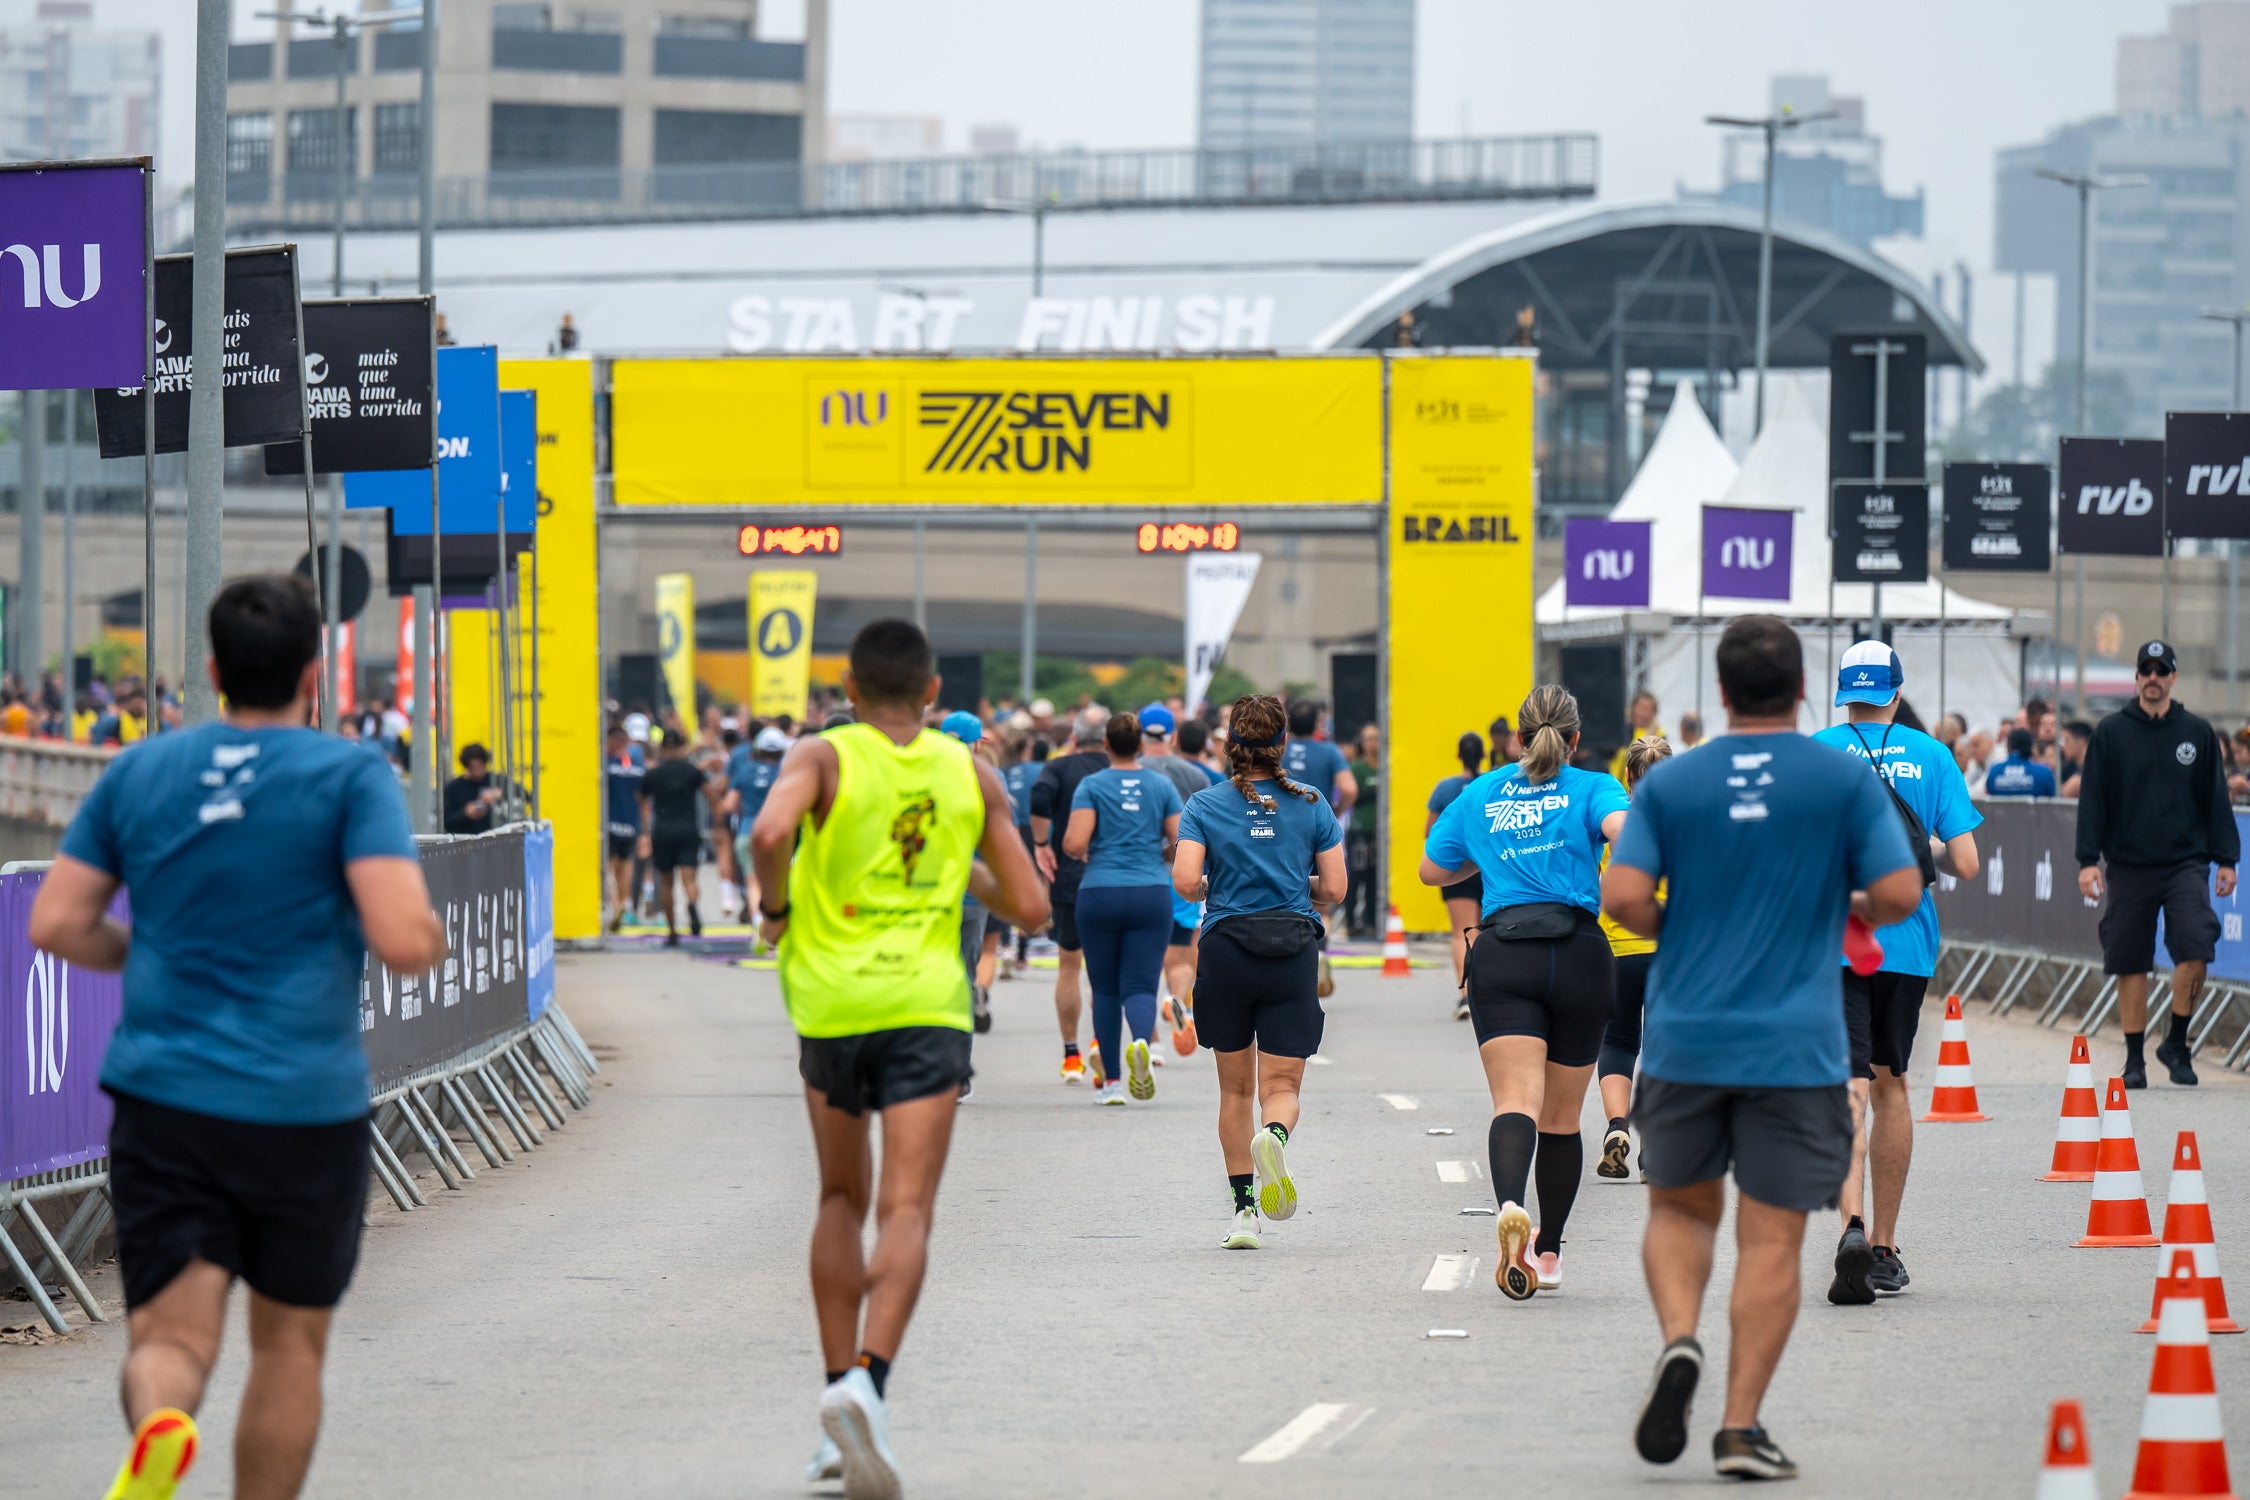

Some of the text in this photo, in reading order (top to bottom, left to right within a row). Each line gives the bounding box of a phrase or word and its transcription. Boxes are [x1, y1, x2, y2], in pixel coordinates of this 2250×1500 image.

[223, 309, 250, 329] ais
[727, 295, 1278, 354] START FINISH
[225, 333, 241, 348] ue
[223, 351, 251, 368] ma
[358, 348, 398, 367] mais
[222, 364, 281, 387] orrida
[358, 369, 389, 389] que
[360, 386, 396, 401] uma
[360, 398, 422, 418] corrida
[821, 389, 888, 427] nu
[1005, 391, 1169, 430] SEVEN
[978, 435, 1090, 473] RUN
[2076, 477, 2154, 516] rvb
[1404, 516, 1520, 544] BRASIL
[1721, 536, 1775, 570] nu
[1582, 549, 1635, 581] nu
[1862, 745, 1906, 759] NEWON
[1517, 782, 1558, 795] NEWON
[1512, 794, 1569, 815] SEVEN
[1503, 810, 1543, 831] RUN
[1514, 827, 1542, 840] 2025
